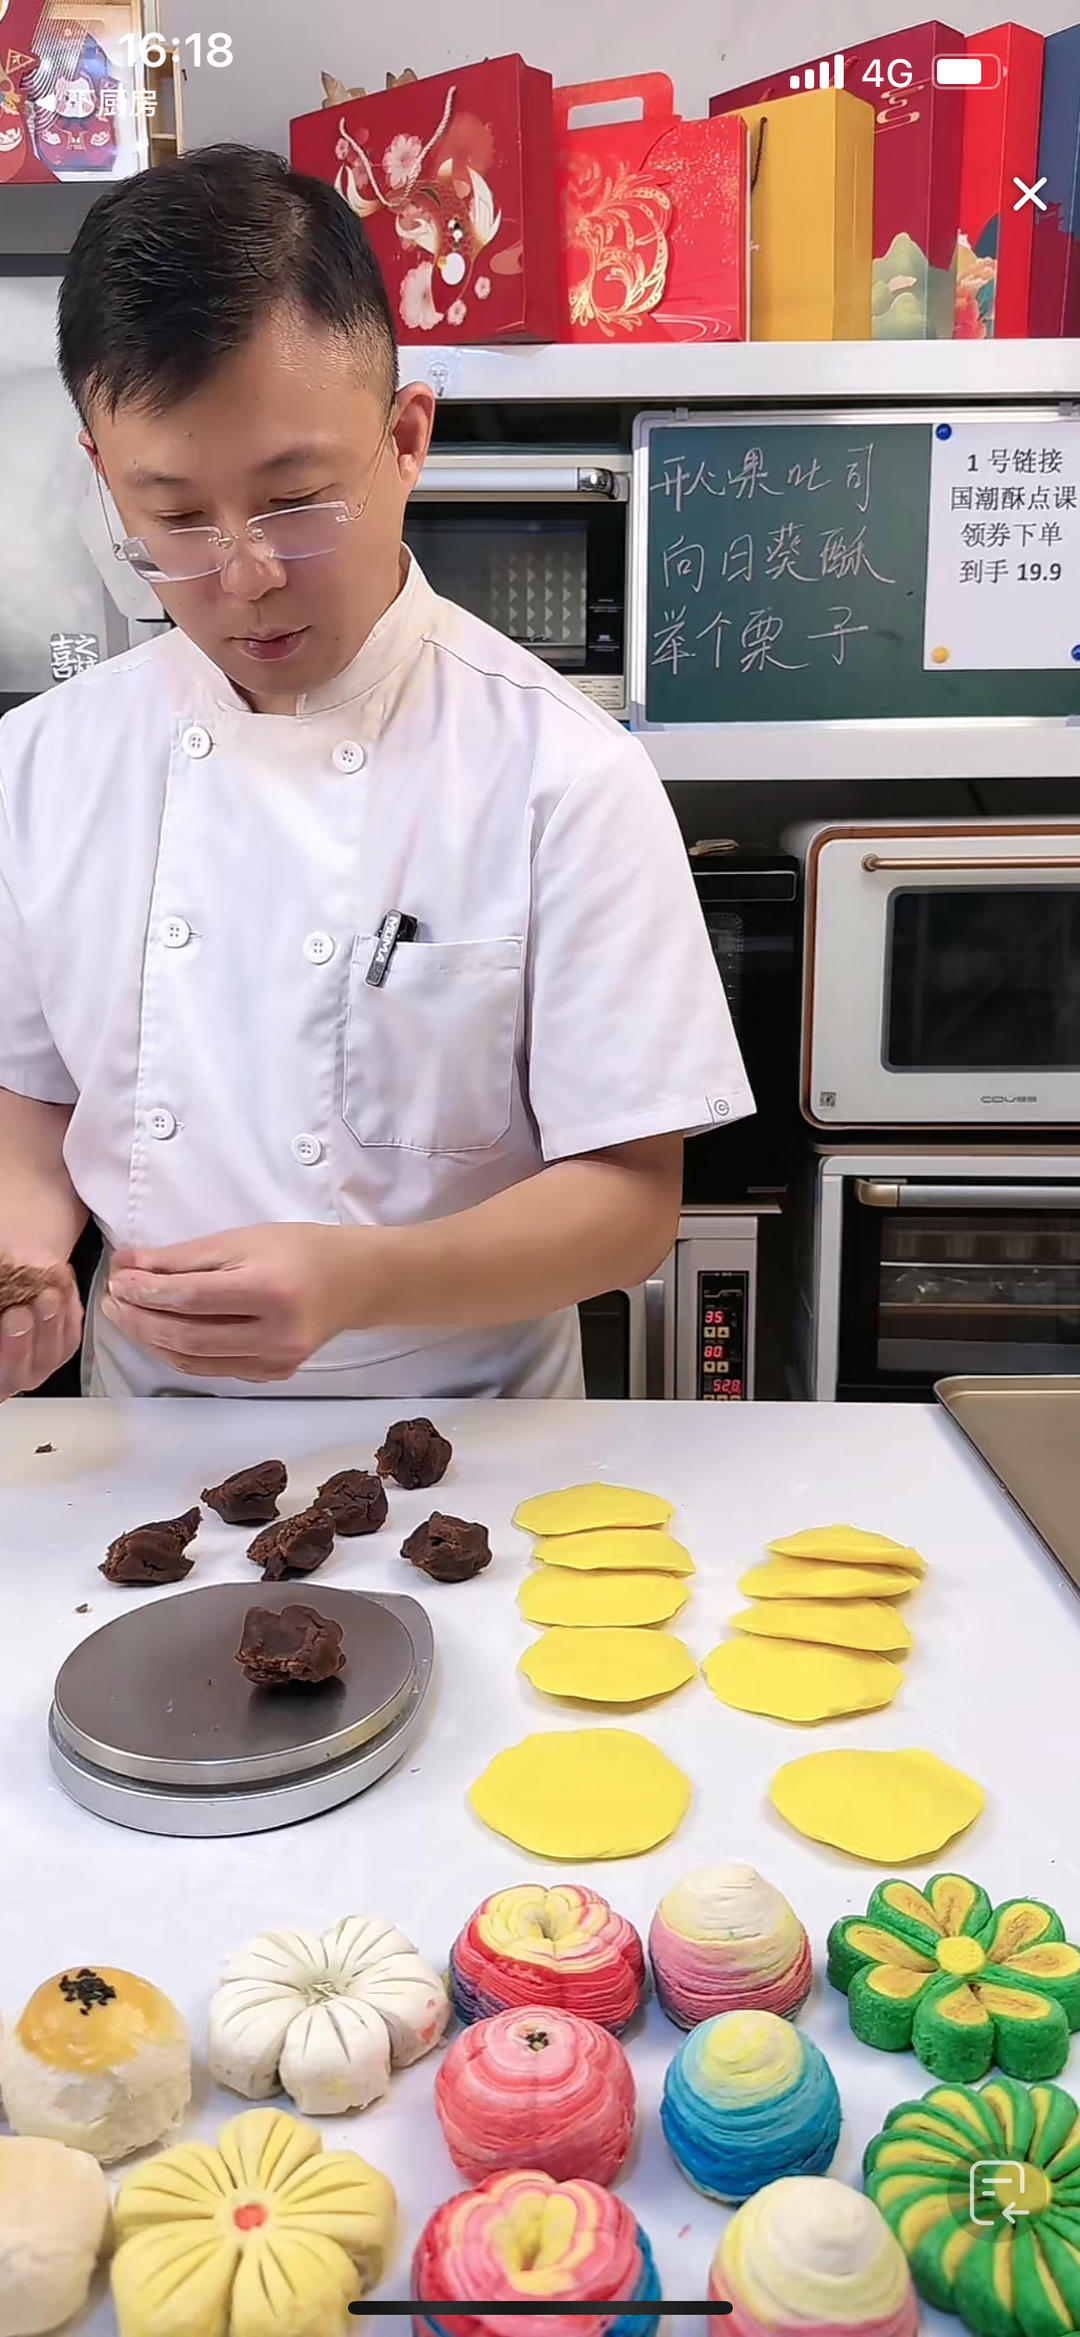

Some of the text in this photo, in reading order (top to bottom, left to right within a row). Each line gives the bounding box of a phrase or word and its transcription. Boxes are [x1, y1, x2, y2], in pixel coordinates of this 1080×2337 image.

[951, 485, 1077, 511] 国潮酥点课
[960, 521, 1063, 548] 领券下单
[662, 522, 897, 594] 向日葵酥
[651, 605, 870, 676] 举个栗子
[704, 1310, 724, 1324] 35
[703, 1345, 723, 1358] 80
